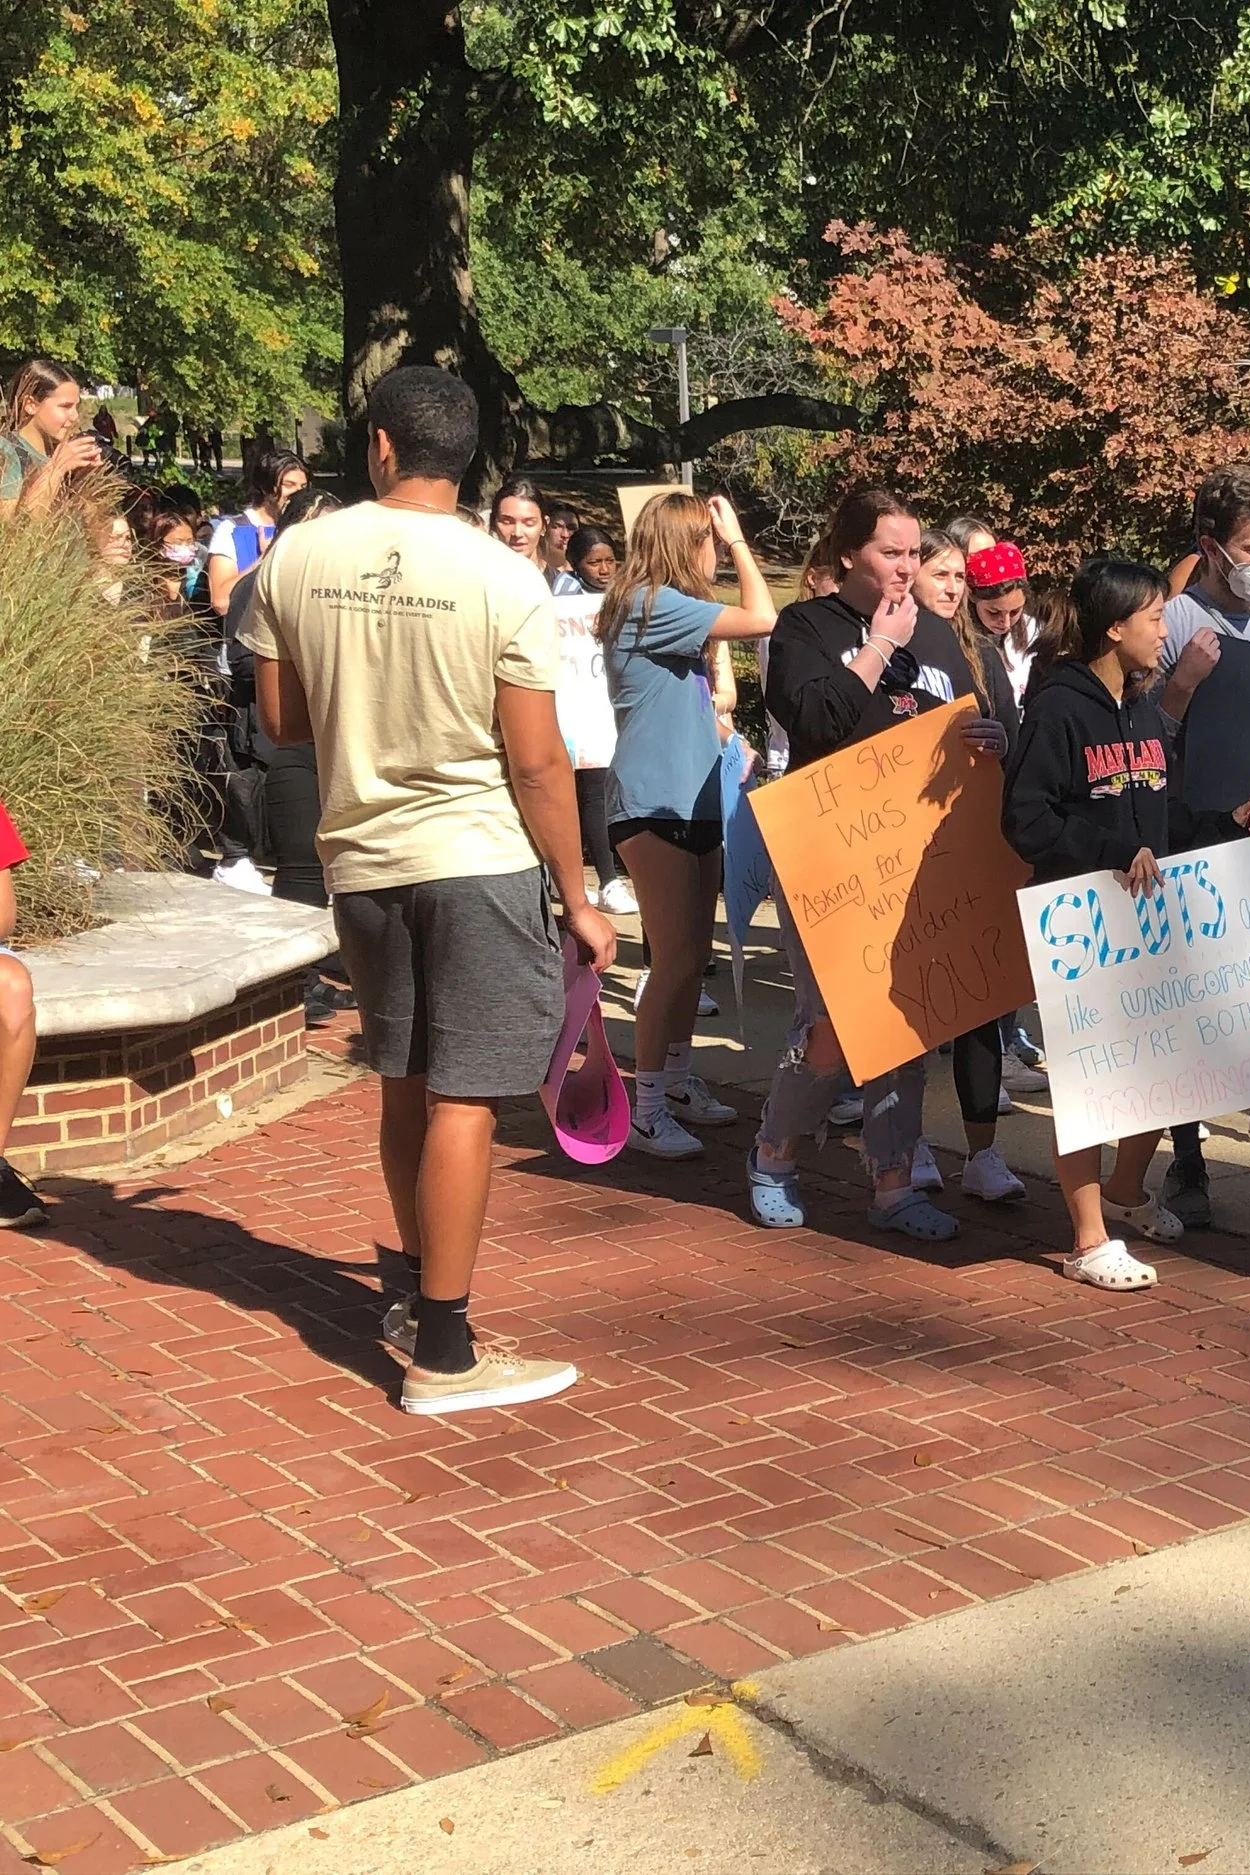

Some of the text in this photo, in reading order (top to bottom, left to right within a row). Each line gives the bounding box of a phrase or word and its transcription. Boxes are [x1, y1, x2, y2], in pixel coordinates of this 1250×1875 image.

[311, 588, 457, 612] PERMANENT PARADISE
[856, 742, 914, 791] She
[875, 847, 904, 880] for
[1039, 859, 1227, 981] SLUTS
[888, 925, 1001, 1038] YOU?
[1064, 994, 1104, 1035] like
[1067, 1025, 1182, 1079] THEY'RE
